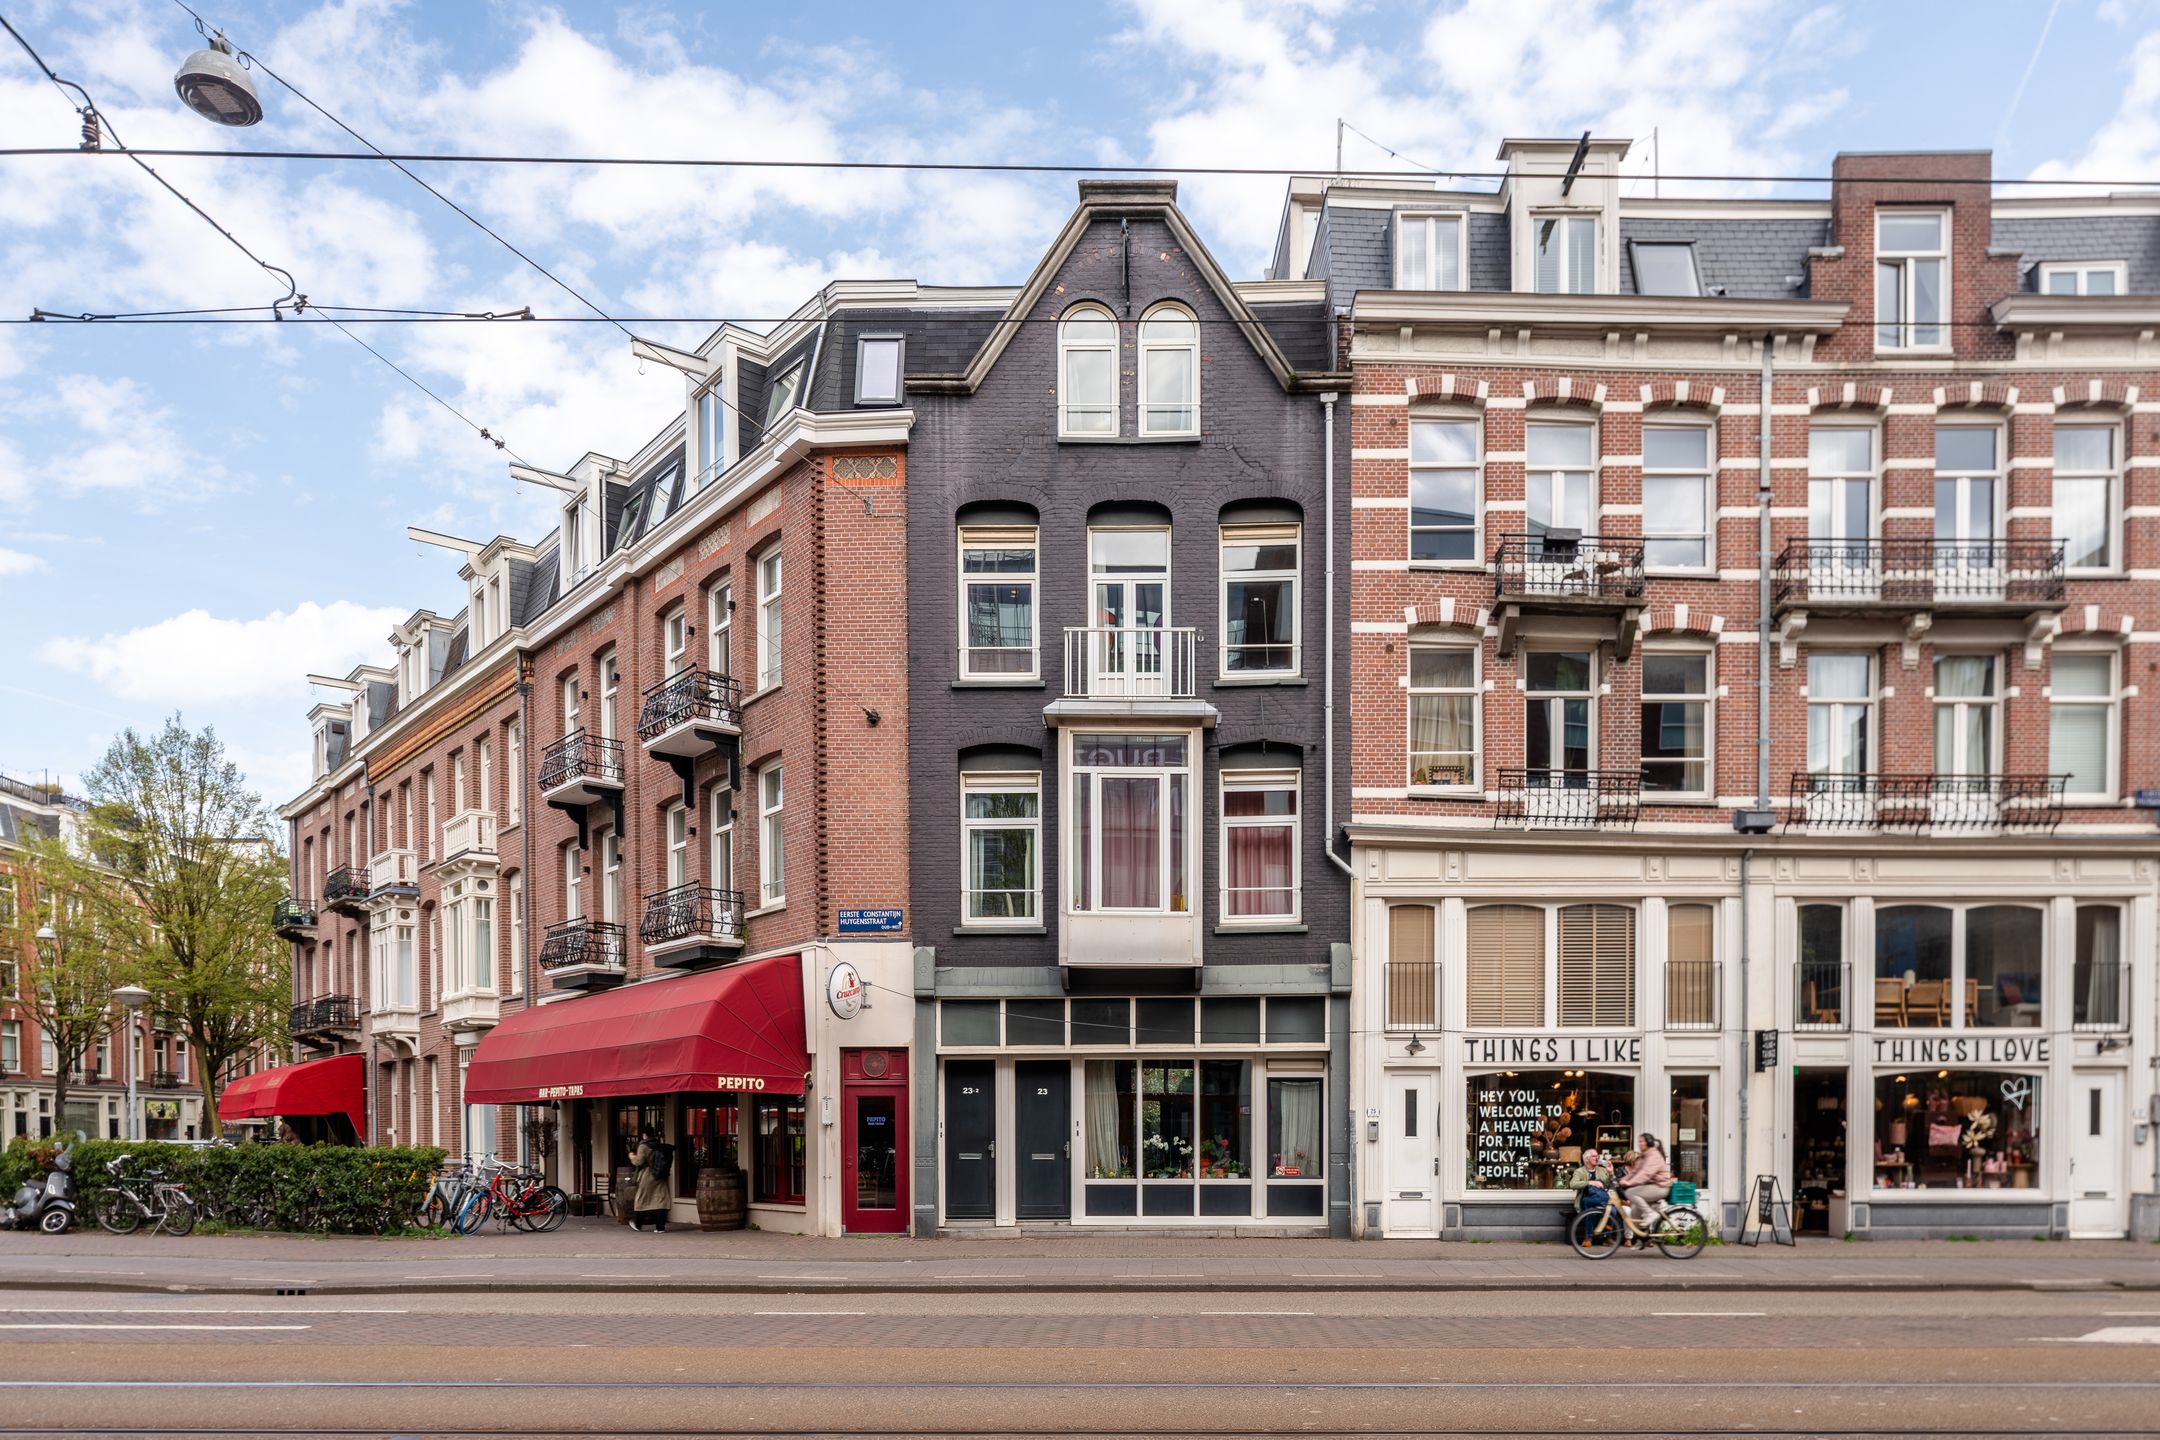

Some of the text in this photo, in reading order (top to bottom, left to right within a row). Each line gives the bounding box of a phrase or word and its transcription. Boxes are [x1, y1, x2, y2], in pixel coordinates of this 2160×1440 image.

[863, 911, 901, 919] CONSTANTIJN
[1464, 1038, 1640, 1062] THINGS I LIKE
[1873, 1038, 2050, 1062] THINGS I LOVE
[717, 1076, 765, 1090] PEPITO
[1480, 1090, 1539, 1103] HEY YOU,
[1479, 1105, 1562, 1117] WELCOME TO
[1480, 1121, 1544, 1132] A HEAVEN
[1479, 1135, 1530, 1147] FOR THE
[1479, 1150, 1516, 1162] PICKY
[1479, 1166, 1528, 1178] PEOPLE.
